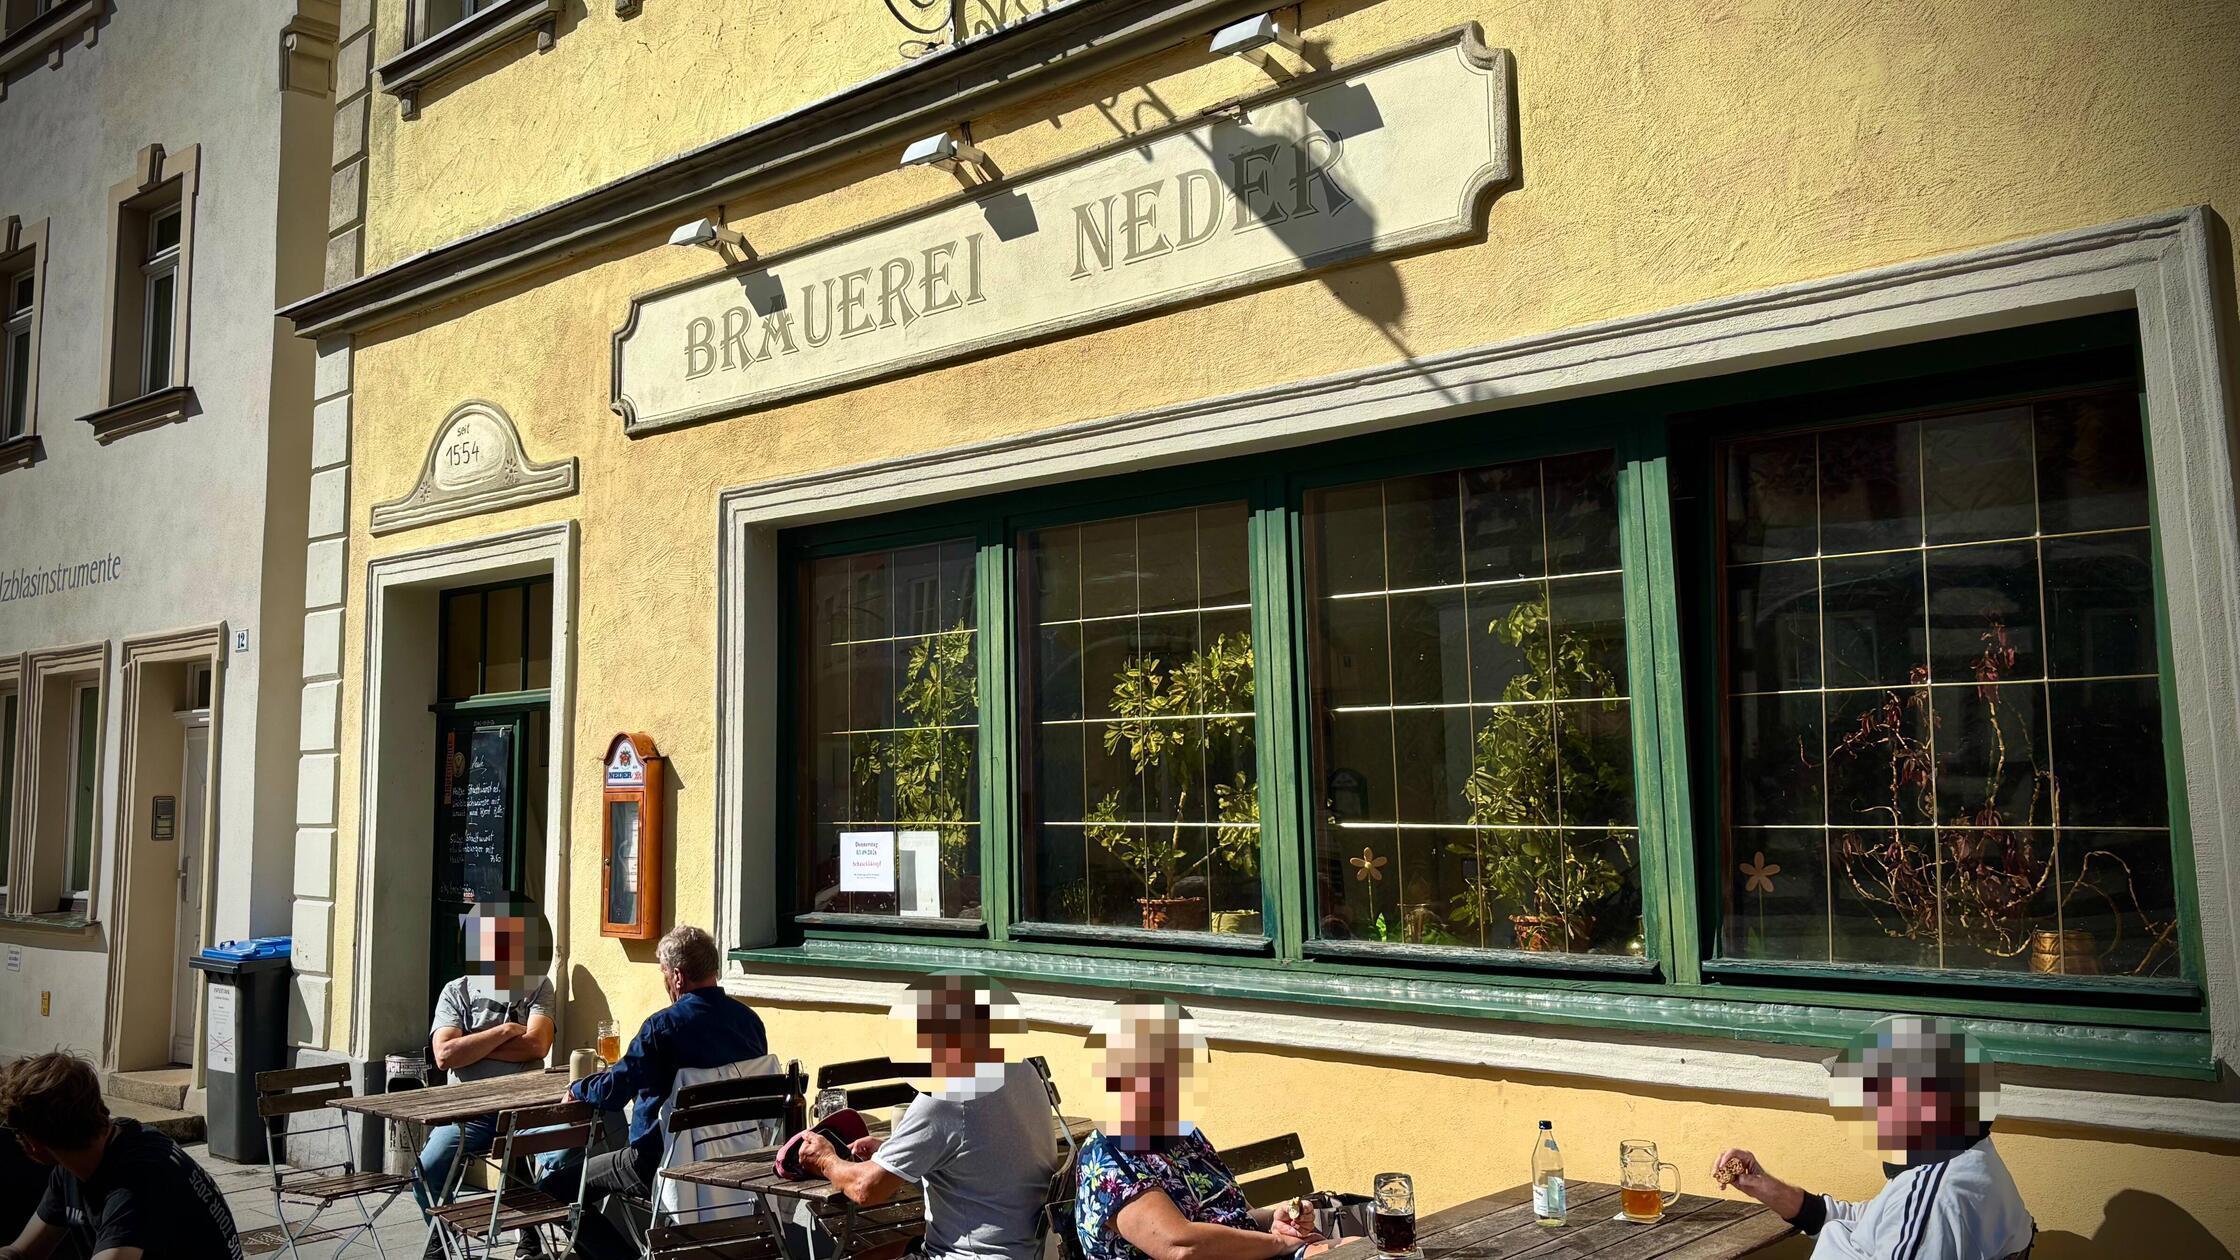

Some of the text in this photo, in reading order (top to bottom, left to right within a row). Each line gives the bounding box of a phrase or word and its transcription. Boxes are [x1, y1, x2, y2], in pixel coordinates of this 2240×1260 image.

[684, 129, 1354, 380] BRAUEREI NEDER
[457, 423, 470, 437] seit
[445, 441, 480, 466] 1554
[237, 632, 246, 649] 12
[189, 1170, 213, 1203] 2025
[209, 1197, 233, 1238] TOUR
